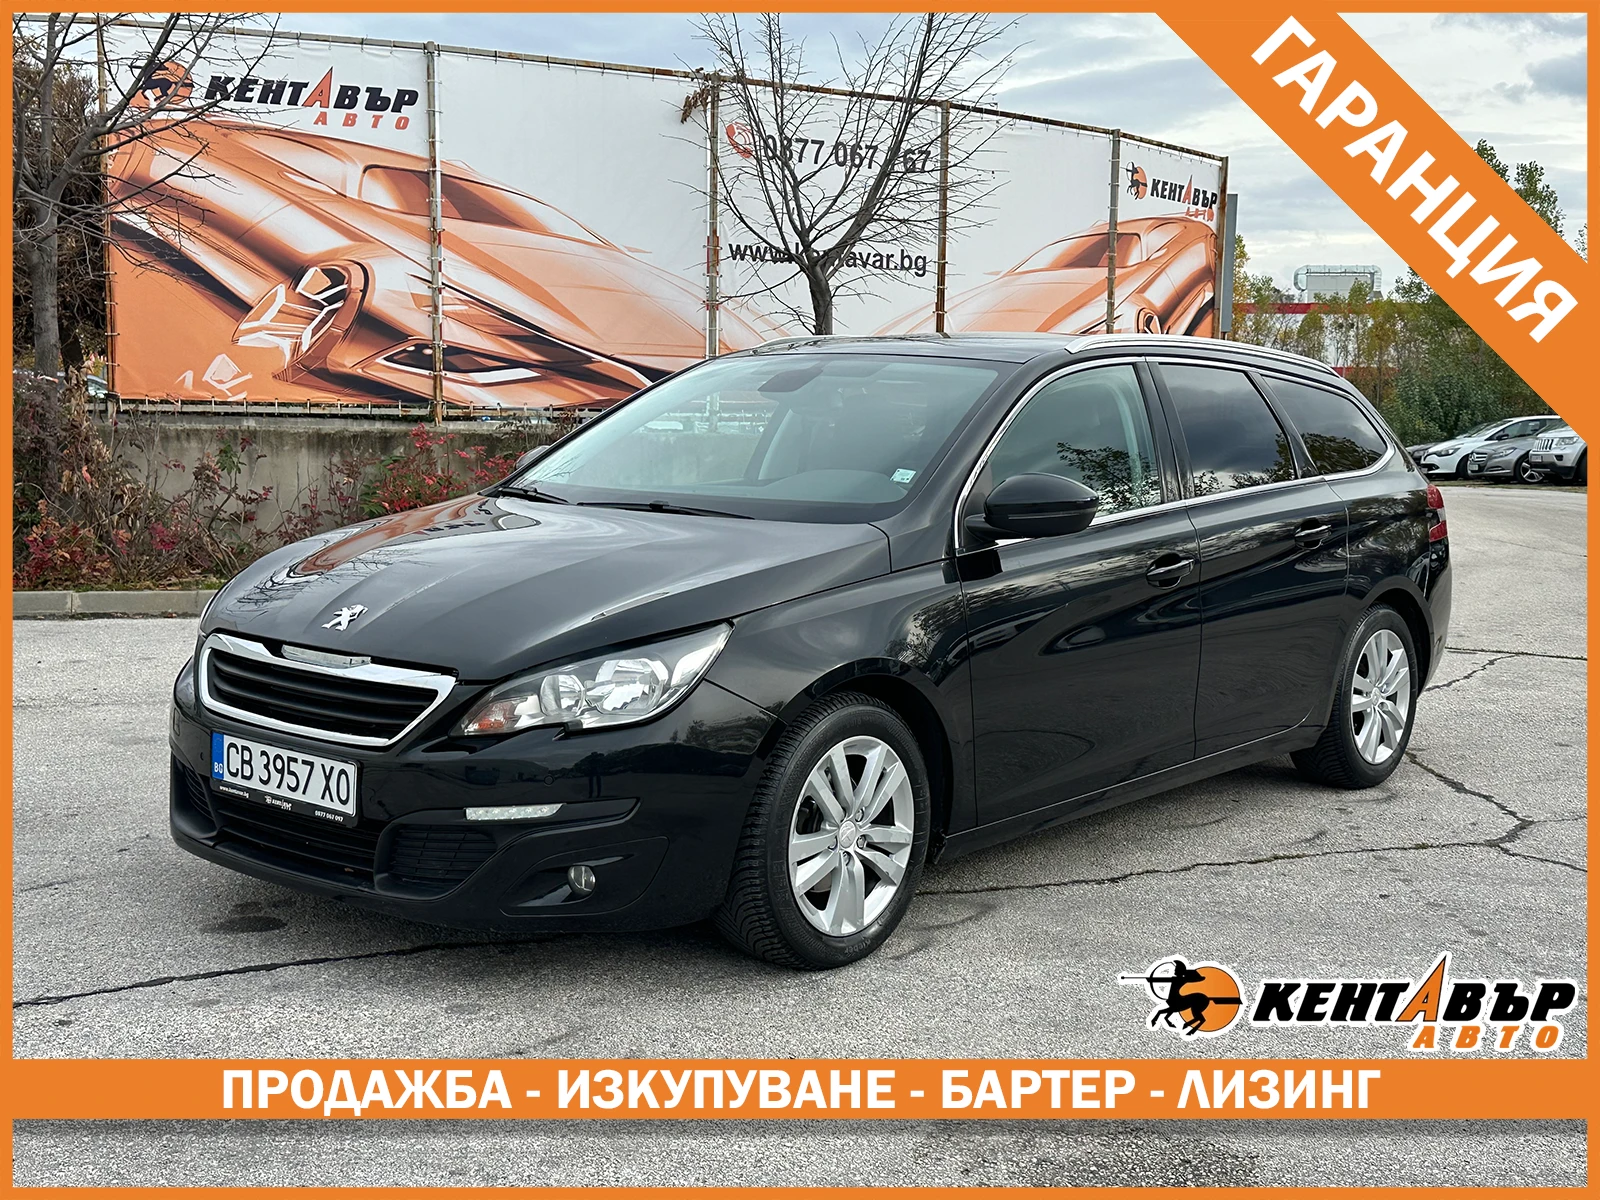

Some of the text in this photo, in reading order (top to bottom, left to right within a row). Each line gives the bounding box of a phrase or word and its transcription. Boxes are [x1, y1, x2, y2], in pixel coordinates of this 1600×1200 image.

[205, 66, 419, 113] КЕНТАВЪР
[313, 111, 410, 130] АВТО
[834, 141, 878, 170] 067
[1150, 174, 1218, 209] КЕНТАВЪР
[214, 762, 224, 774] BG
[258, 750, 314, 795] 3957
